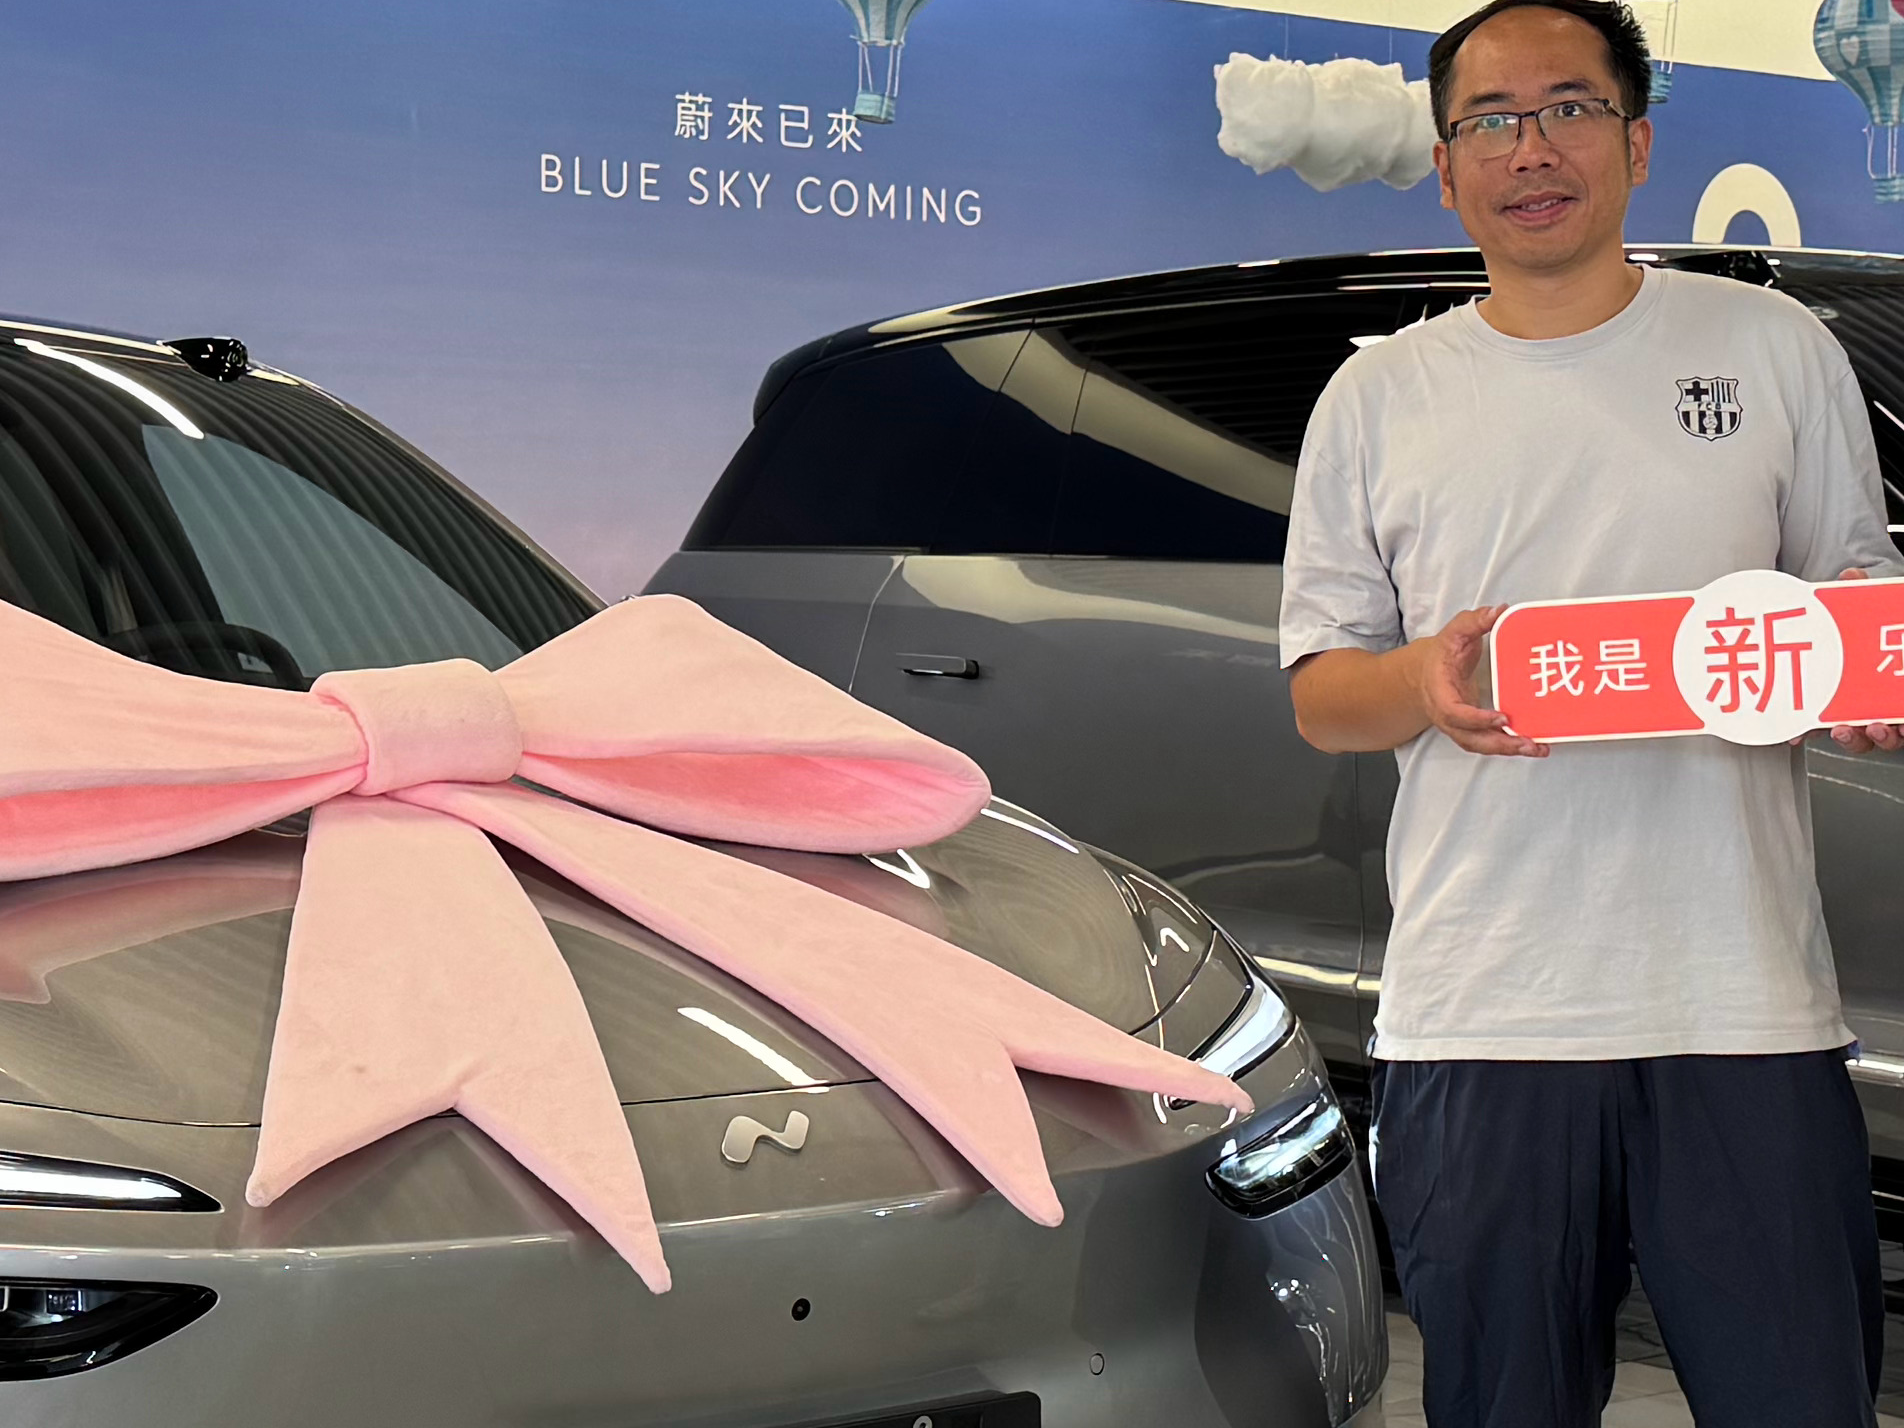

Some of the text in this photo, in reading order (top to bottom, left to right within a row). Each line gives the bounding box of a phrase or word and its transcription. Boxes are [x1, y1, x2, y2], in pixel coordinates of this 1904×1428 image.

[674, 91, 863, 153] 蔚來已來
[540, 153, 983, 227] BLUE SKY COMING
[1529, 638, 1651, 698] 我是
[1704, 605, 1814, 715] 新
